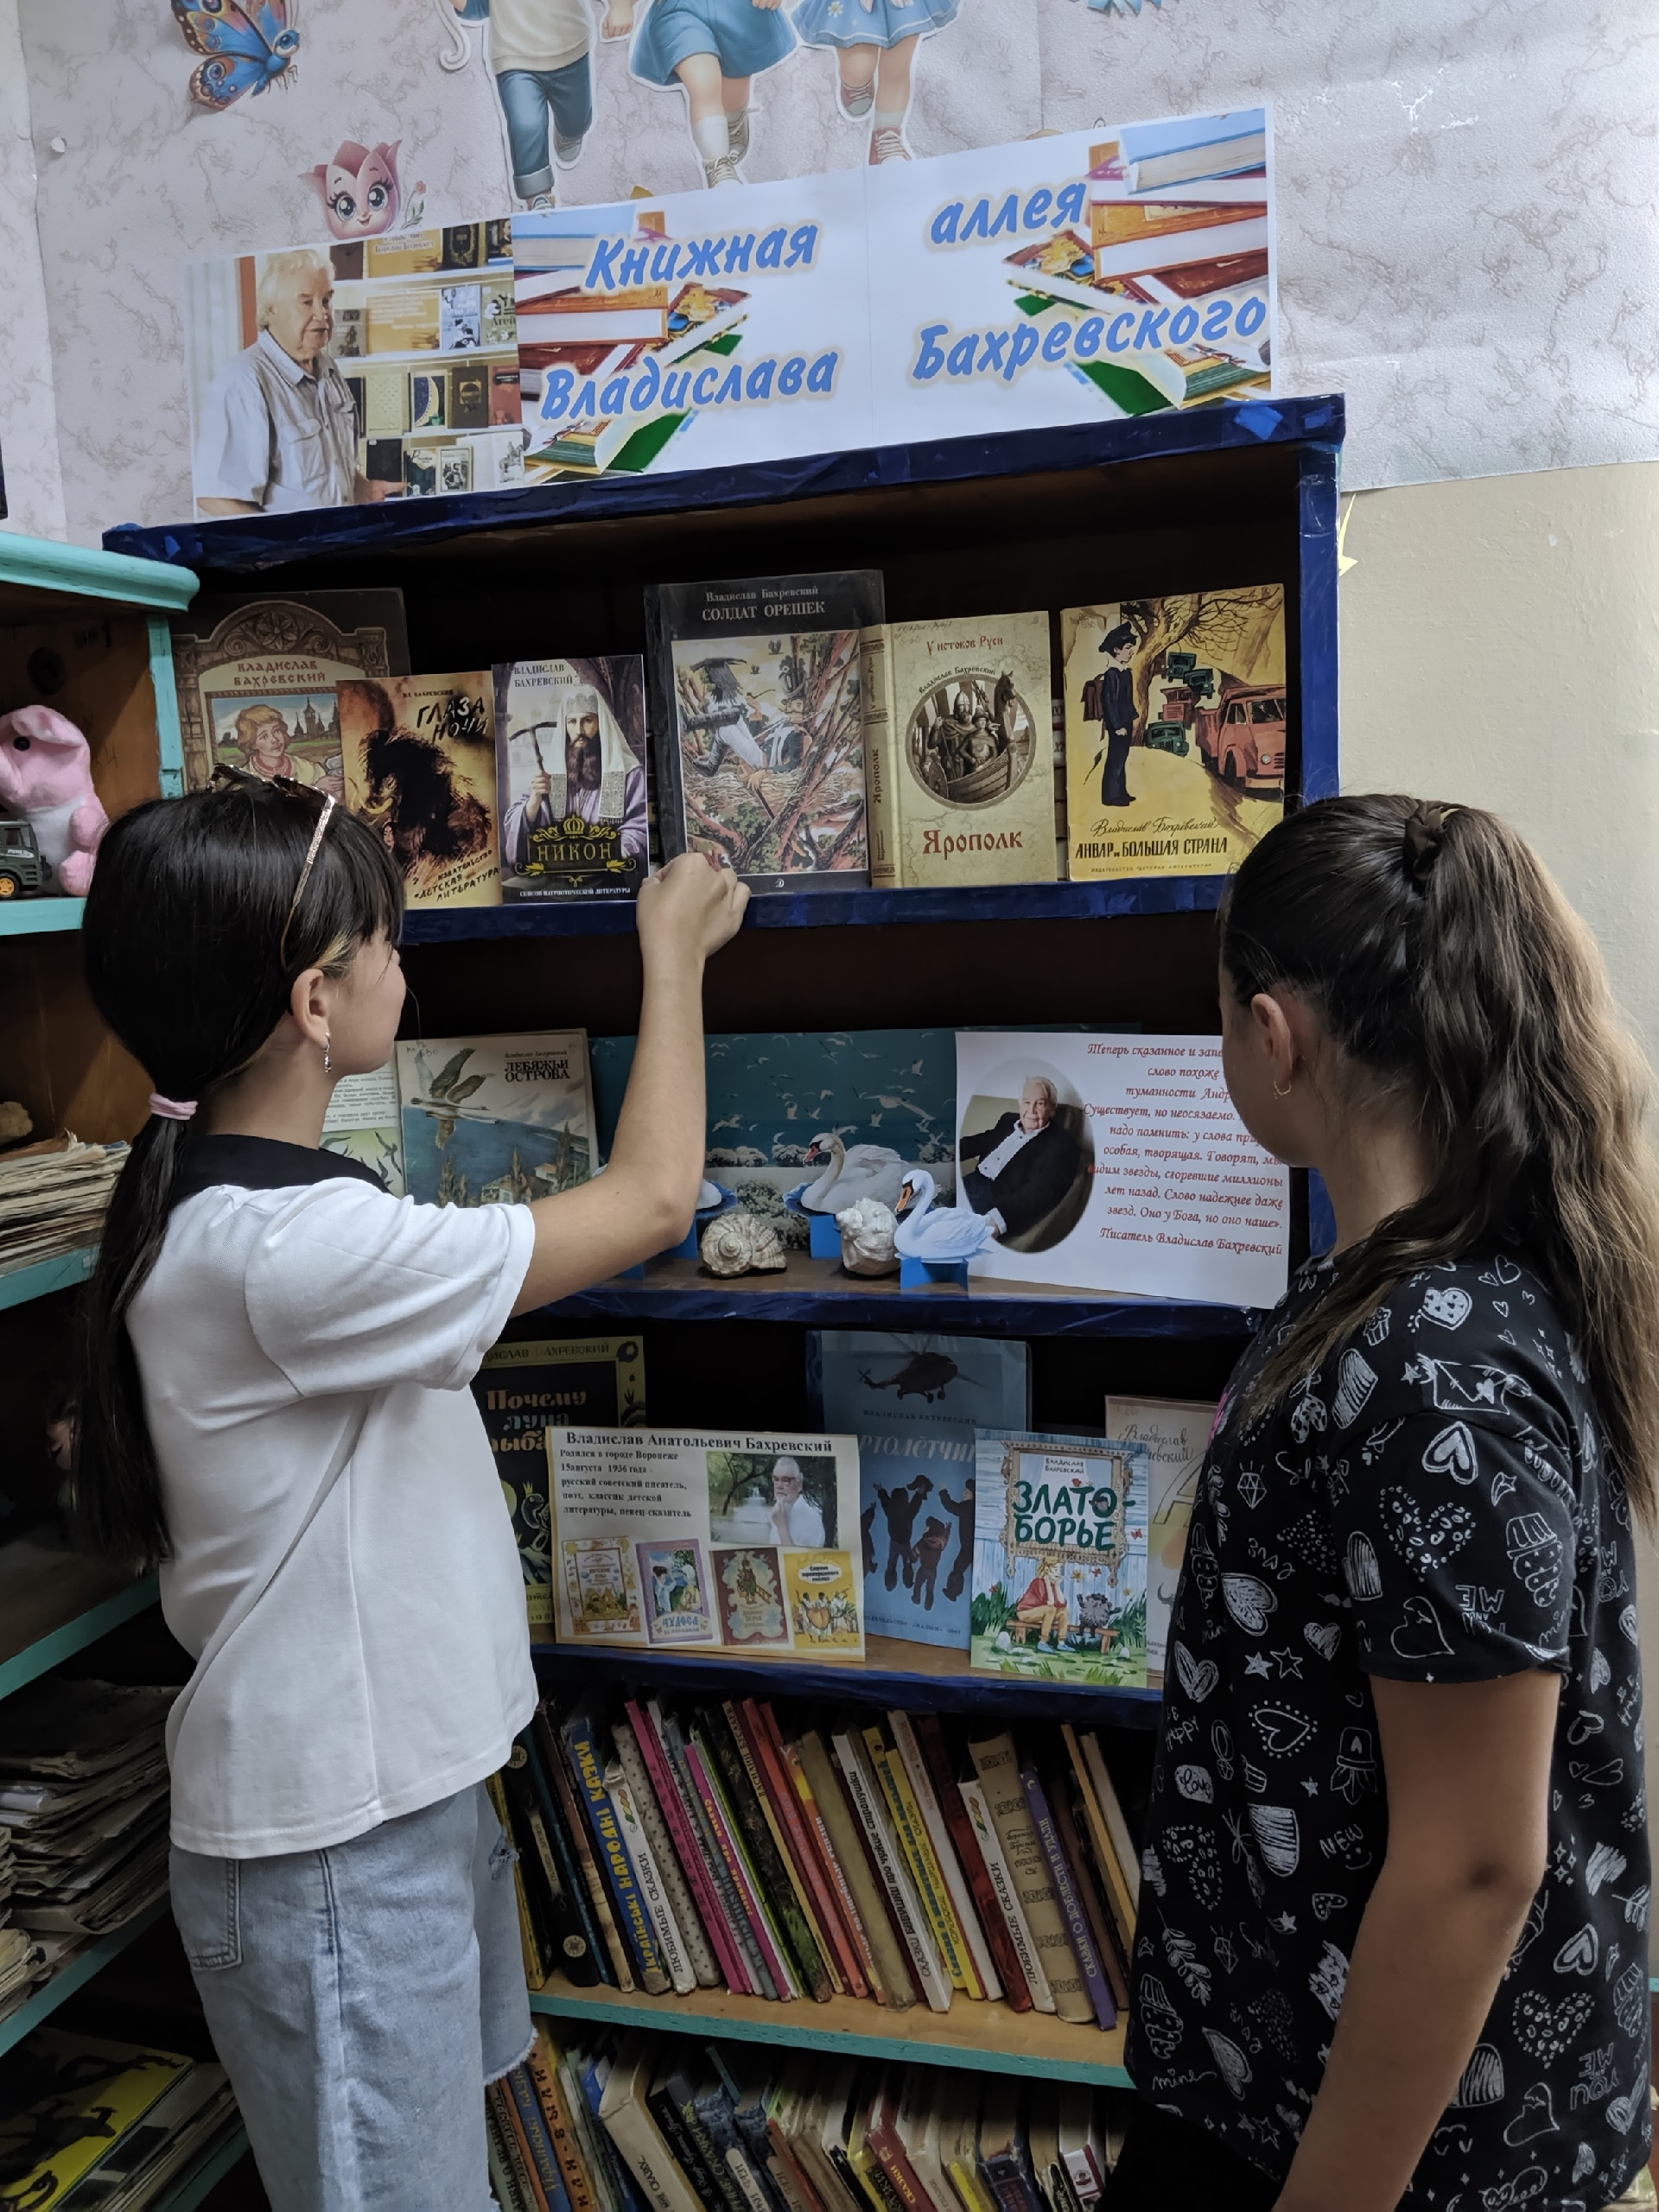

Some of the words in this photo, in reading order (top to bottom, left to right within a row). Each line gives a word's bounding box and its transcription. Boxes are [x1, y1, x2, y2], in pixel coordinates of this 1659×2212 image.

[584, 224, 818, 290] Книжная
[931, 182, 1087, 244] аллея
[540, 352, 837, 420] Владислава
[913, 296, 1267, 380] Бахревского
[706, 589, 757, 603] Владислав
[760, 584, 819, 601] Бахревский
[702, 605, 757, 622] СОЛДАТ
[764, 601, 825, 618] ОРЕШЕК
[926, 640, 934, 655] У
[936, 639, 976, 652] истоков
[979, 635, 1004, 649] Руси
[238, 659, 319, 673] ВЛАДИСЛАВ
[513, 663, 565, 675] ВЛАДИСЛАВ
[233, 671, 327, 689] БАХРЕВСКИЙ
[514, 675, 575, 688] БАХРЕВСКИЙ
[416, 696, 485, 728] ГЛАЗА
[432, 717, 489, 743] НОЧИ
[872, 748, 883, 804] Ярополк
[537, 842, 612, 862] НИКОН
[921, 829, 1023, 861] Ярополк
[1076, 842, 1114, 860] АНВАР
[1122, 840, 1179, 857] БОЛЬШАЯ
[1183, 837, 1228, 854] СТРАНА
[1088, 1043, 1129, 1058] Теперь
[1133, 1047, 1185, 1058] сказанное
[505, 1059, 569, 1071] ЛЕБЯЖЬИ
[505, 1070, 570, 1082] ОСТРОВА
[1147, 1068, 1176, 1077] слово
[1179, 1069, 1219, 1080] похоже
[1126, 1087, 1196, 1099] туманности
[1200, 1088, 1230, 1103] Андр
[1084, 1103, 1150, 1118] Существует,
[1171, 1110, 1235, 1121] неосязаемо.
[1110, 1123, 1134, 1136] надо
[1137, 1128, 1189, 1139] помнить:
[1192, 1131, 1200, 1142] у
[1203, 1132, 1232, 1141] слова
[1103, 1144, 1141, 1159] особая,
[1144, 1149, 1202, 1160] творящая.
[1207, 1150, 1259, 1166] Говорят,
[1087, 1163, 1120, 1175] видим
[1123, 1165, 1160, 1179] звезды,
[1164, 1170, 1219, 1183] сгоревшие
[1222, 1175, 1283, 1186] миллионы
[1104, 1186, 1125, 1195] лет
[1128, 1186, 1160, 1198] назад.
[1164, 1189, 1196, 1200] Слово
[1199, 1192, 1251, 1206] надежнее
[1255, 1193, 1283, 1210] даже
[1107, 1205, 1136, 1217] звезд.
[1140, 1206, 1161, 1218] Оно
[1164, 1211, 1171, 1222] у
[1173, 1209, 1201, 1224] Бога,
[1205, 1215, 1218, 1224] но
[1222, 1217, 1242, 1225] оно
[1245, 1219, 1282, 1229] наше».
[1100, 1227, 1153, 1242] Писатель
[1156, 1232, 1214, 1248] Владислав
[1217, 1238, 1282, 1255] Бахревский
[486, 1389, 587, 1410] Почему
[502, 1412, 570, 1432] луна
[566, 1432, 643, 1446] Владислав
[647, 1436, 741, 1449] Анатольевич
[745, 1438, 833, 1453] Бахревский
[560, 1449, 595, 1459] Родился
[605, 1452, 633, 1460] городе
[635, 1451, 678, 1461] Воронеже
[1044, 1456, 1084, 1467] ВЛАДИСЛАВ
[607, 1465, 627, 1473] 1936
[1044, 1465, 1085, 1474] БАХРЕВСКИЙ
[562, 1478, 596, 1487] русский
[599, 1479, 642, 1488] советский
[645, 1480, 687, 1490] писатель,
[588, 1492, 624, 1501] классик
[627, 1494, 663, 1503] детской
[1013, 1481, 1136, 1518] ЗЛАТО-
[1014, 1516, 1116, 1551] БОРЬЕ
[574, 1740, 607, 1803] КАЗКИ
[1038, 1818, 1058, 1852] УДАЛИ
[1319, 1824, 1364, 1859] NEW
[596, 1808, 633, 1889] НАРОДНІ
[870, 1830, 891, 1864] чужие
[1050, 1853, 1062, 1864] И
[638, 1853, 660, 1901] СКАЗКИ
[883, 1860, 898, 1886] про
[990, 1863, 1014, 1911] СКАЗКИ
[1072, 1922, 1084, 1934] О
[654, 1905, 683, 1974] ЛЮБИМЫЕ
[1007, 1915, 1038, 1985] ЛЮБИМЫЕ
[1077, 1935, 1098, 1978] СКАЗКИ
[1152, 2068, 1217, 2090] mine
[890, 2165, 917, 2205] СКАЗКИ
